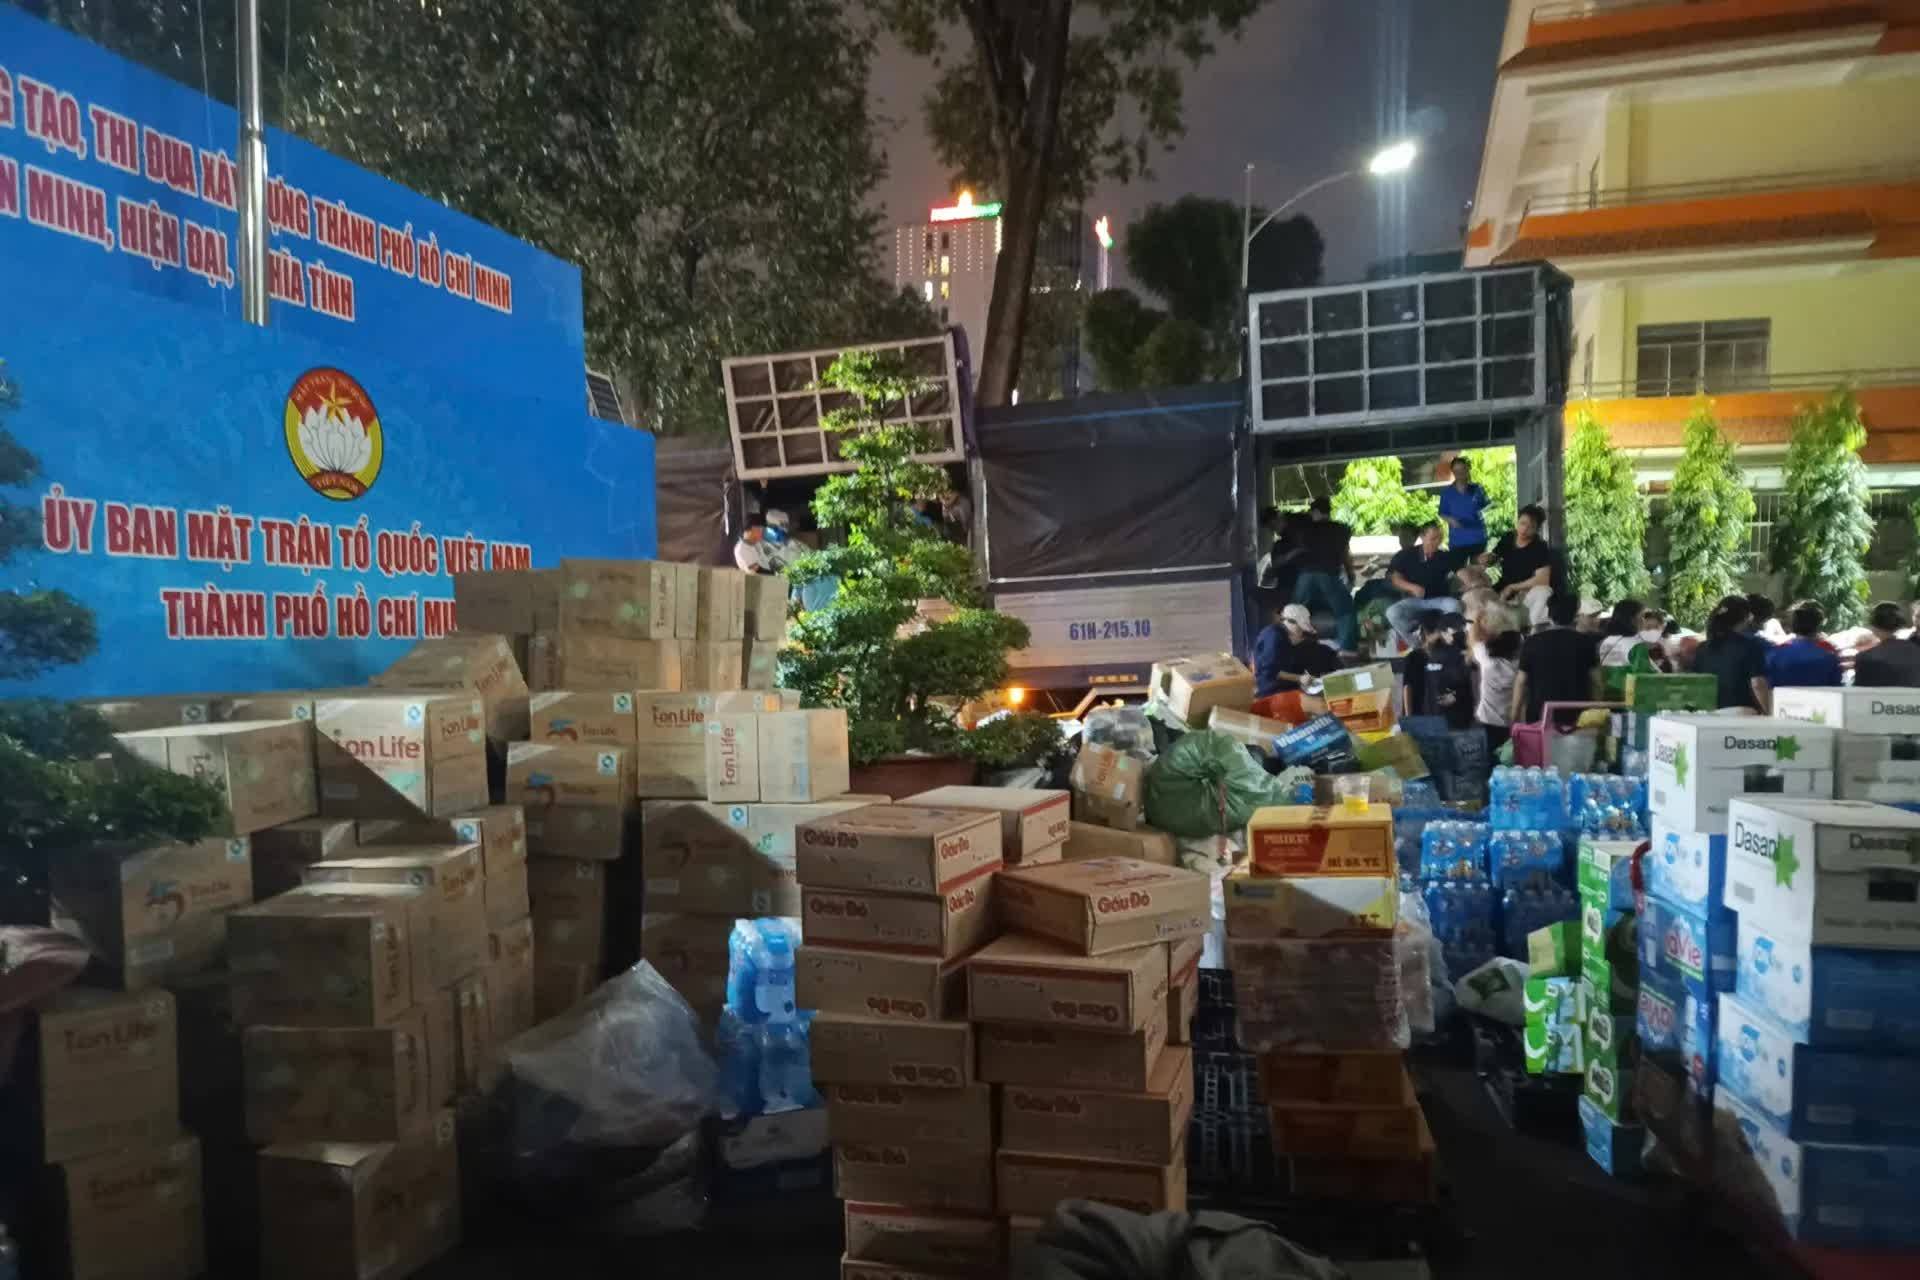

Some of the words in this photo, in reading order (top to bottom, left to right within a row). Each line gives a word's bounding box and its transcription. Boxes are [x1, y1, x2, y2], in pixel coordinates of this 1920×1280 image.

[18, 75, 86, 159] TẠO,
[89, 104, 140, 175] THI
[267, 176, 310, 239] ỰNG
[312, 196, 377, 264] THÀNH
[379, 221, 415, 278] PHỐ
[417, 231, 441, 288] HỒ
[443, 250, 472, 300] CHÍ
[473, 262, 512, 314] MINH
[25, 164, 114, 251] MINH,
[118, 195, 181, 270] HIỆN
[268, 246, 306, 308] HĨA
[307, 258, 355, 322] TÌNH
[43, 483, 96, 554] ỦY
[104, 501, 179, 559] BAN
[186, 504, 253, 572] MẶT
[259, 513, 333, 576] TRẬN
[337, 513, 371, 572] TỔ
[376, 519, 439, 578] QUỐC
[489, 541, 532, 570] NAM
[160, 582, 266, 640] THÀNH
[274, 579, 330, 640] PHỐ
[335, 581, 371, 640] HỒ
[376, 591, 418, 640] CHÍ
[379, 736, 422, 759] Life
